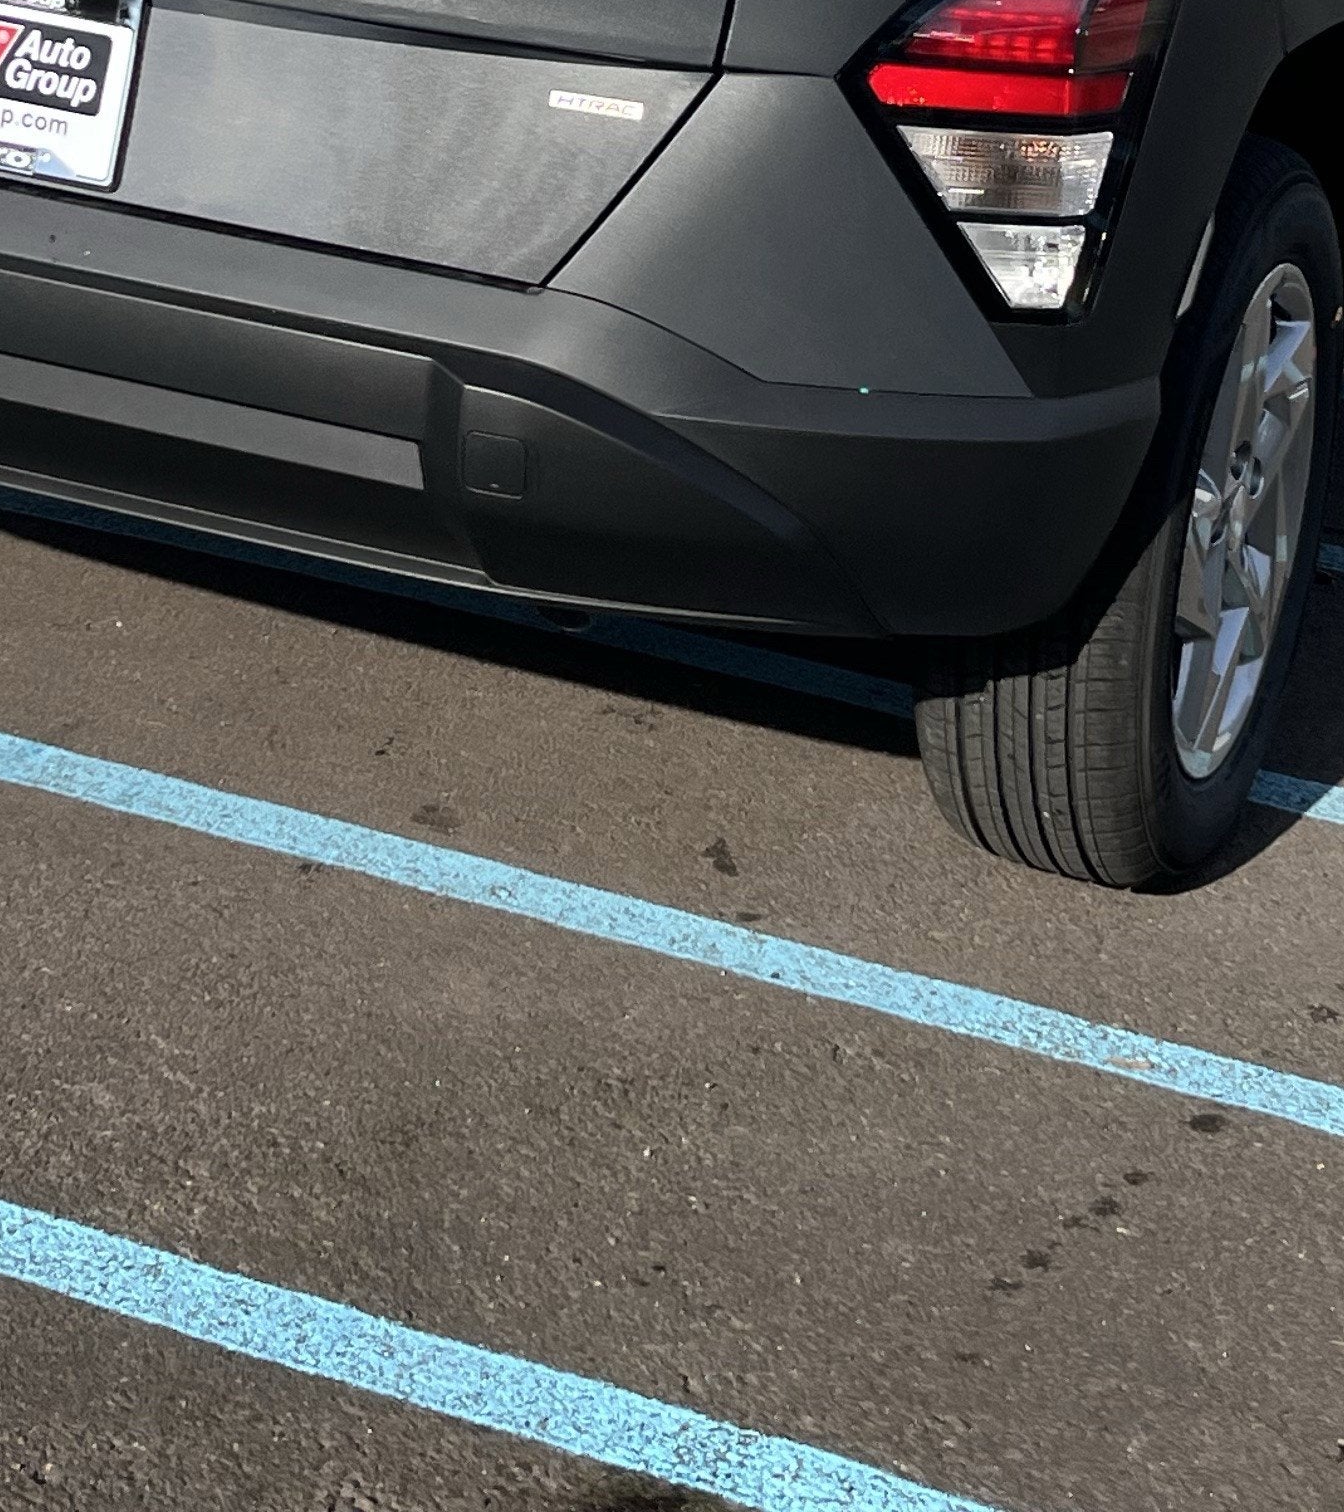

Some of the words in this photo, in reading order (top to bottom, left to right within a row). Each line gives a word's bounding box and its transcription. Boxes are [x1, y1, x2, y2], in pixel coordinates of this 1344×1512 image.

[14, 29, 92, 69] Auto
[5, 58, 98, 107] Group
[557, 94, 637, 117] HTRAC
